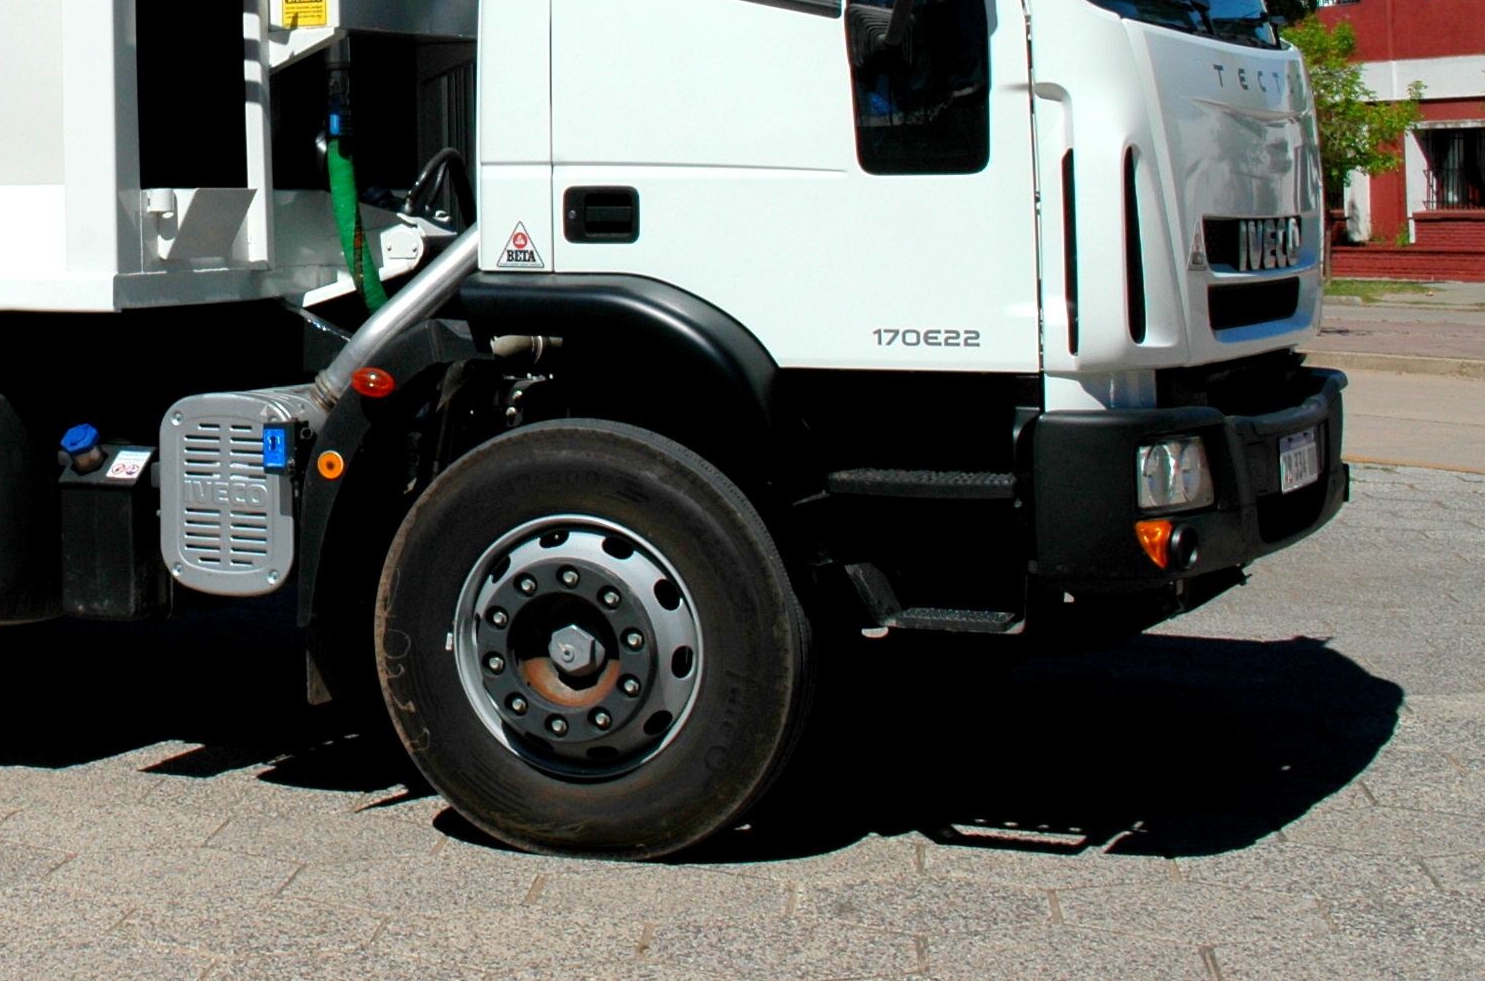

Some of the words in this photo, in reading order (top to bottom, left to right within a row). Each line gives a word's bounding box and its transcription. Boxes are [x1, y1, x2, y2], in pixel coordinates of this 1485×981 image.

[506, 249, 536, 262] BETA
[1238, 217, 1301, 272] IVECO
[872, 328, 981, 347] 170E22
[183, 480, 268, 507] IVECO
